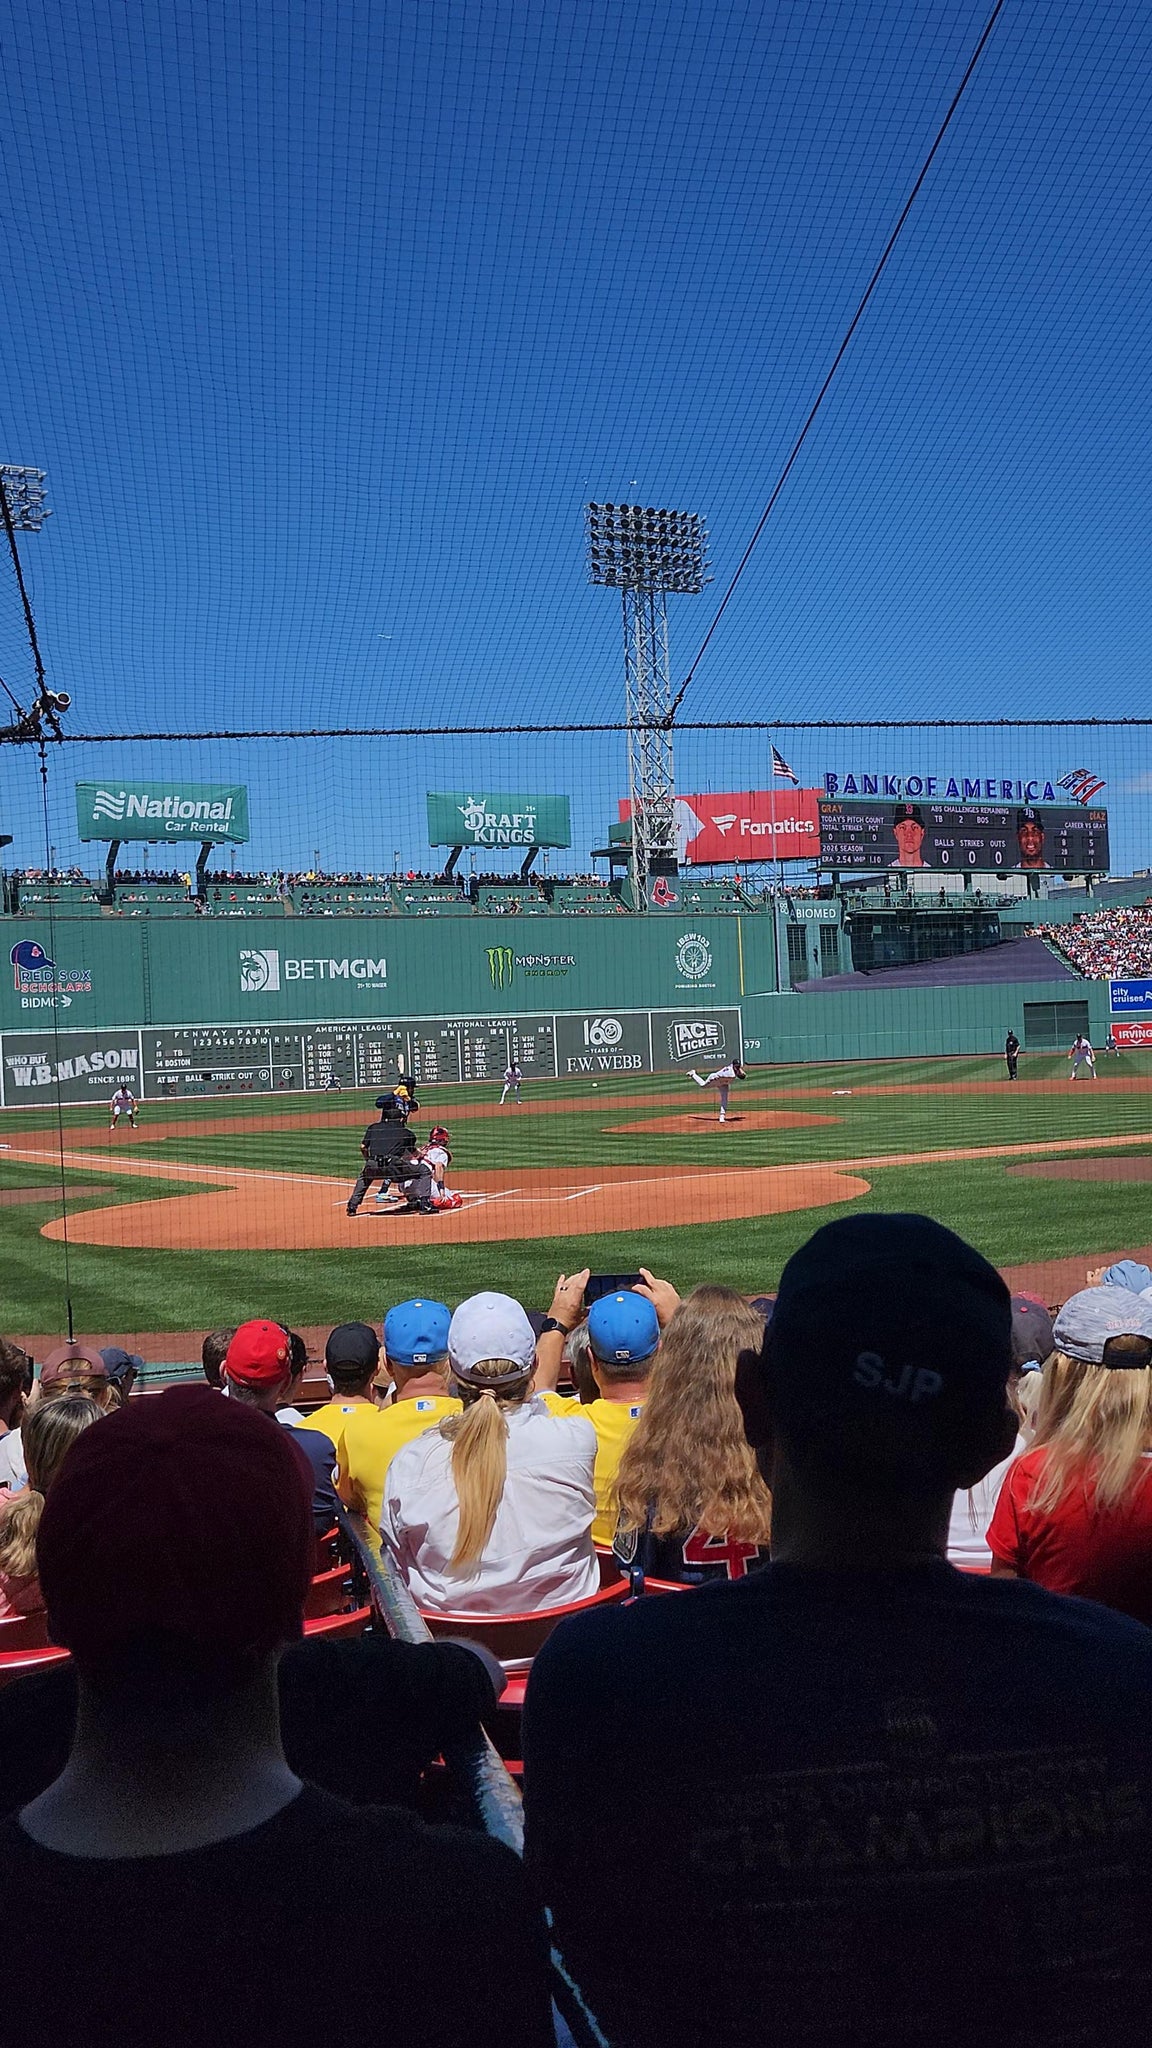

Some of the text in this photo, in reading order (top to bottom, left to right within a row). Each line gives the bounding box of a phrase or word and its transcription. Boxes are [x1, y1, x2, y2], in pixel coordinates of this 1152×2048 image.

[825, 772, 1056, 801] BANK OF AMERICA
[126, 795, 234, 820] National
[821, 804, 843, 813] GRAY
[943, 806, 979, 814] CHALLENGES
[980, 807, 1009, 815] REMAINING
[464, 812, 537, 831] DRAFT
[934, 815, 943, 823] TB
[976, 816, 989, 824] BOS
[1001, 817, 1007, 825] 2
[165, 821, 229, 832] Car Rental
[740, 817, 814, 836] Fanatics
[1092, 822, 1107, 830] GRAY
[474, 828, 535, 844] KINGS
[828, 833, 833, 841] 0
[850, 833, 855, 841] 0
[934, 839, 1006, 848] BALLS STRIKES OUTS
[1089, 839, 1094, 847] 5
[941, 850, 1002, 865] 0 0 0
[790, 908, 837, 919] ABIOMED
[676, 933, 710, 949] IBEW 103
[515, 954, 576, 968] MONSTER
[284, 958, 387, 980] BETMGM
[524, 969, 568, 977] ENERGY
[20, 969, 92, 983] RED SOX
[20, 982, 92, 994] SCHOLARS
[1112, 988, 1128, 996] city
[21, 997, 59, 1008] BIDMC
[1113, 995, 1144, 1003] cruises
[315, 1024, 393, 1034] AMERICAN LEAGUE
[447, 1020, 517, 1029] NATIONAL LEAGUE
[174, 1028, 271, 1038] FENWAY PARK
[358, 1033, 364, 1041] P
[583, 1018, 623, 1046] 160
[678, 1022, 719, 1042] ACE
[1118, 1029, 1152, 1039] IRVING
[193, 1039, 197, 1047] 1
[199, 1038, 205, 1046] 2
[206, 1038, 212, 1046] 3
[215, 1037, 222, 1045] 4
[223, 1037, 228, 1045] 5
[229, 1037, 235, 1045] 6
[238, 1037, 244, 1045] 7
[245, 1036, 251, 1044] 8
[251, 1036, 257, 1044] 9
[260, 1036, 268, 1044] 10
[274, 1036, 280, 1044] R
[307, 1035, 313, 1043] P
[318, 1043, 332, 1051] CWS
[680, 1037, 719, 1053] TICKET
[743, 1040, 760, 1049] 379
[173, 1049, 183, 1057] TB
[6, 1055, 48, 1066] WHO BUT
[165, 1058, 191, 1067] BOSTON
[566, 1054, 643, 1072] F.W. WEBB
[475, 1064, 488, 1072] TEX
[88, 1075, 136, 1085] SINCE 1898
[157, 1075, 180, 1084] AT BAT
[185, 1074, 204, 1082] BALL
[211, 1073, 236, 1082] STRIKE
[238, 1072, 254, 1080] OUT
[853, 1350, 945, 1404] SJP
[682, 1526, 759, 1581] 4
[688, 1781, 1147, 1874] CHAMPIONS
